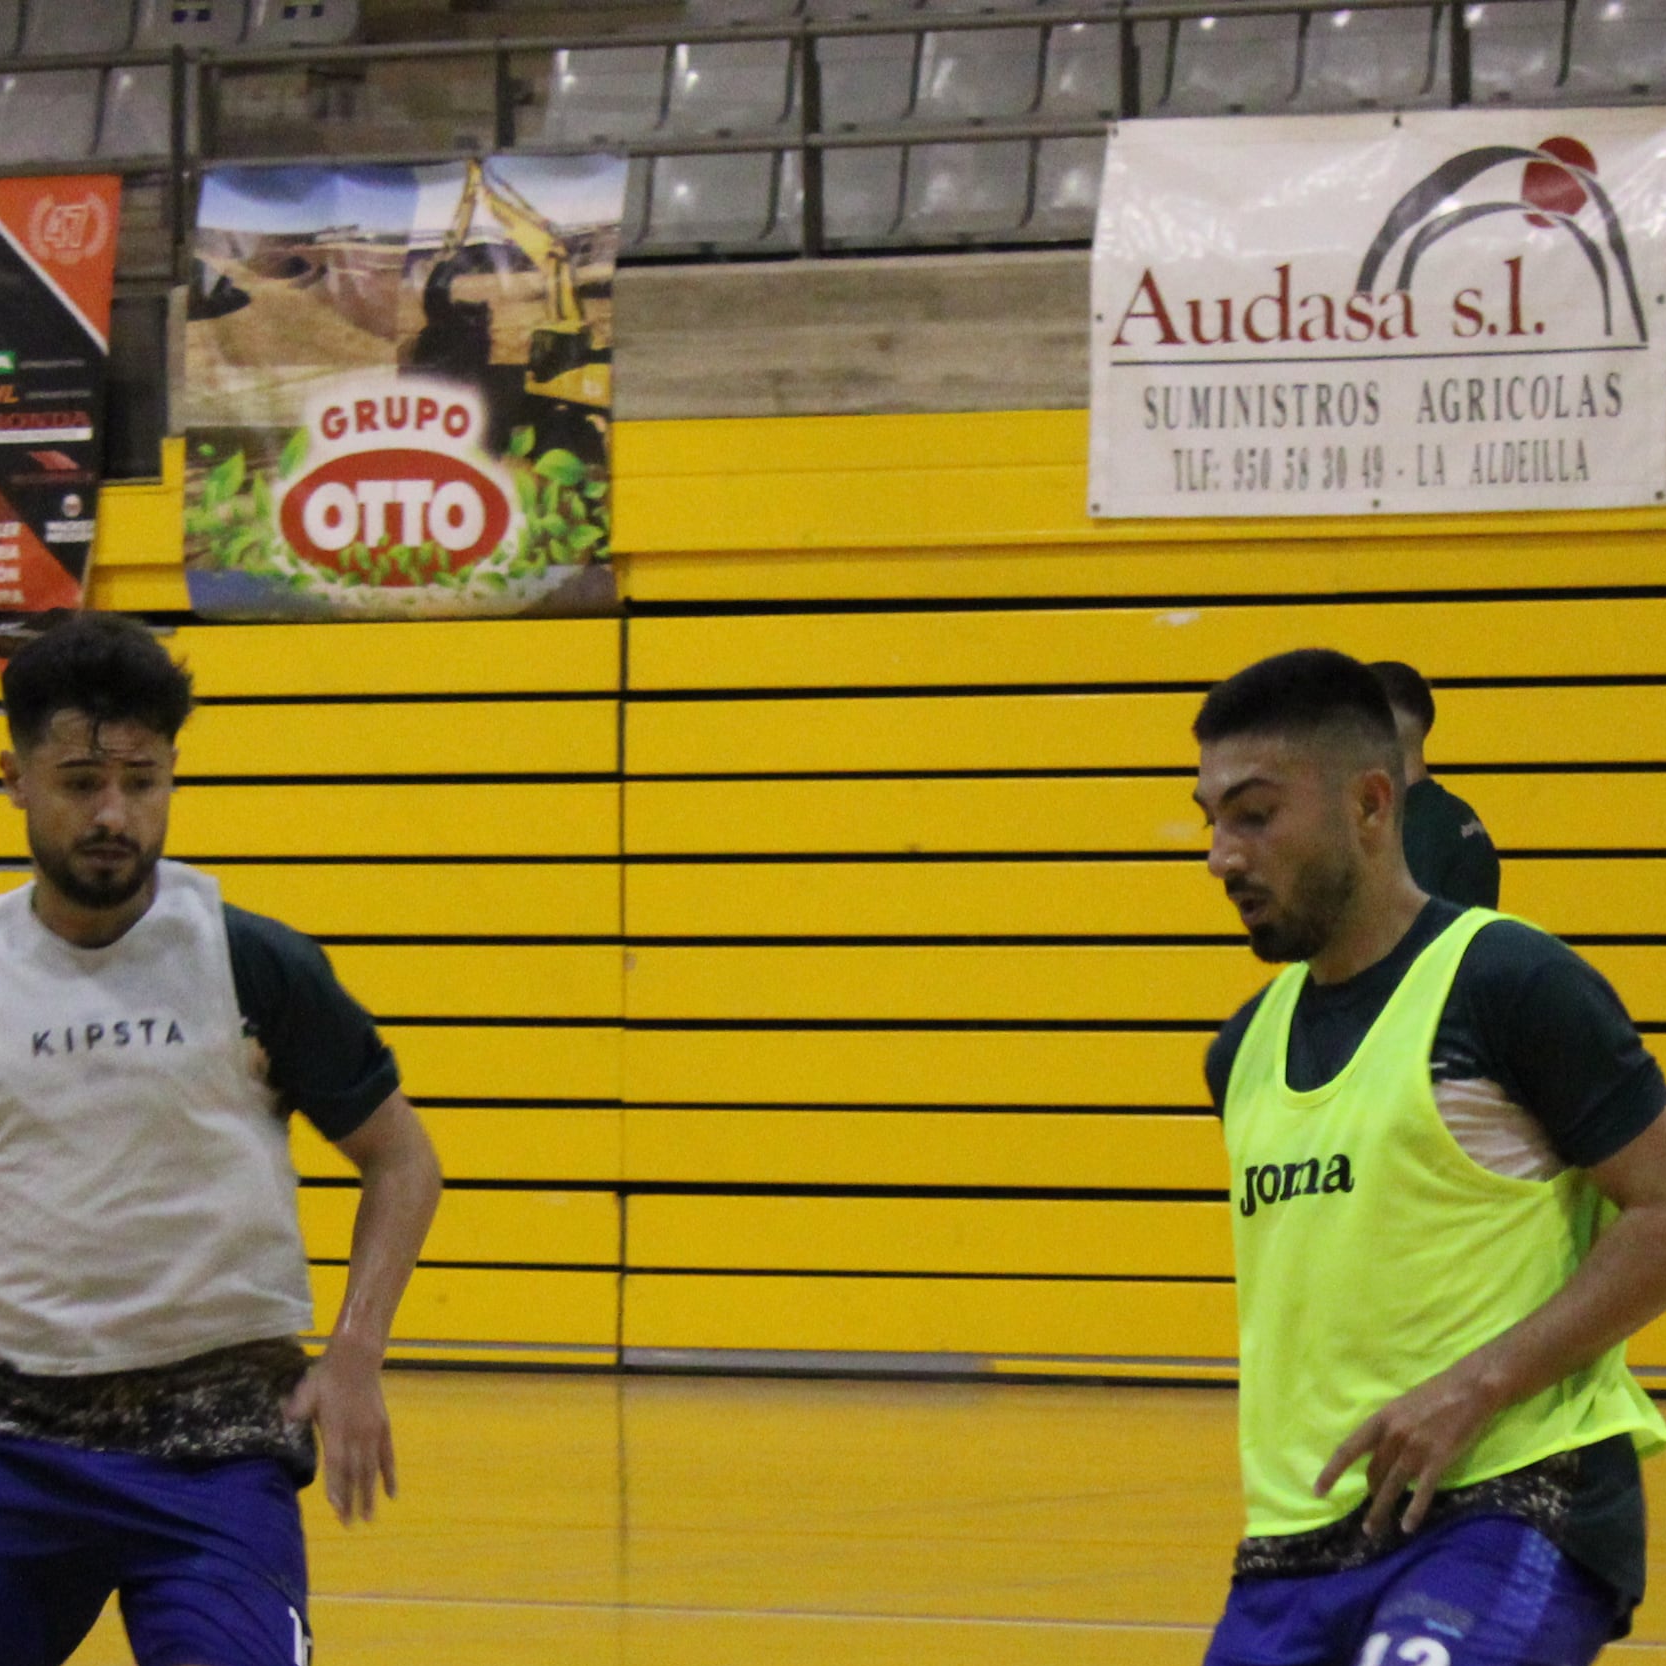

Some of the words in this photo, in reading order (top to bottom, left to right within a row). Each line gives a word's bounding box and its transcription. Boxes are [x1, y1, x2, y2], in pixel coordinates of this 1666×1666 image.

[1111, 263, 1419, 346] Audasa
[1452, 256, 1546, 338] s.l.
[320, 396, 470, 440] GRUPO
[1144, 381, 1381, 430] SUMINISTROS
[1416, 373, 1624, 425] AGRICOLAS
[1233, 446, 1272, 490] 950
[1416, 443, 1446, 486] LA
[302, 479, 485, 551] OTTO
[32, 1019, 186, 1058] KIPSTA
